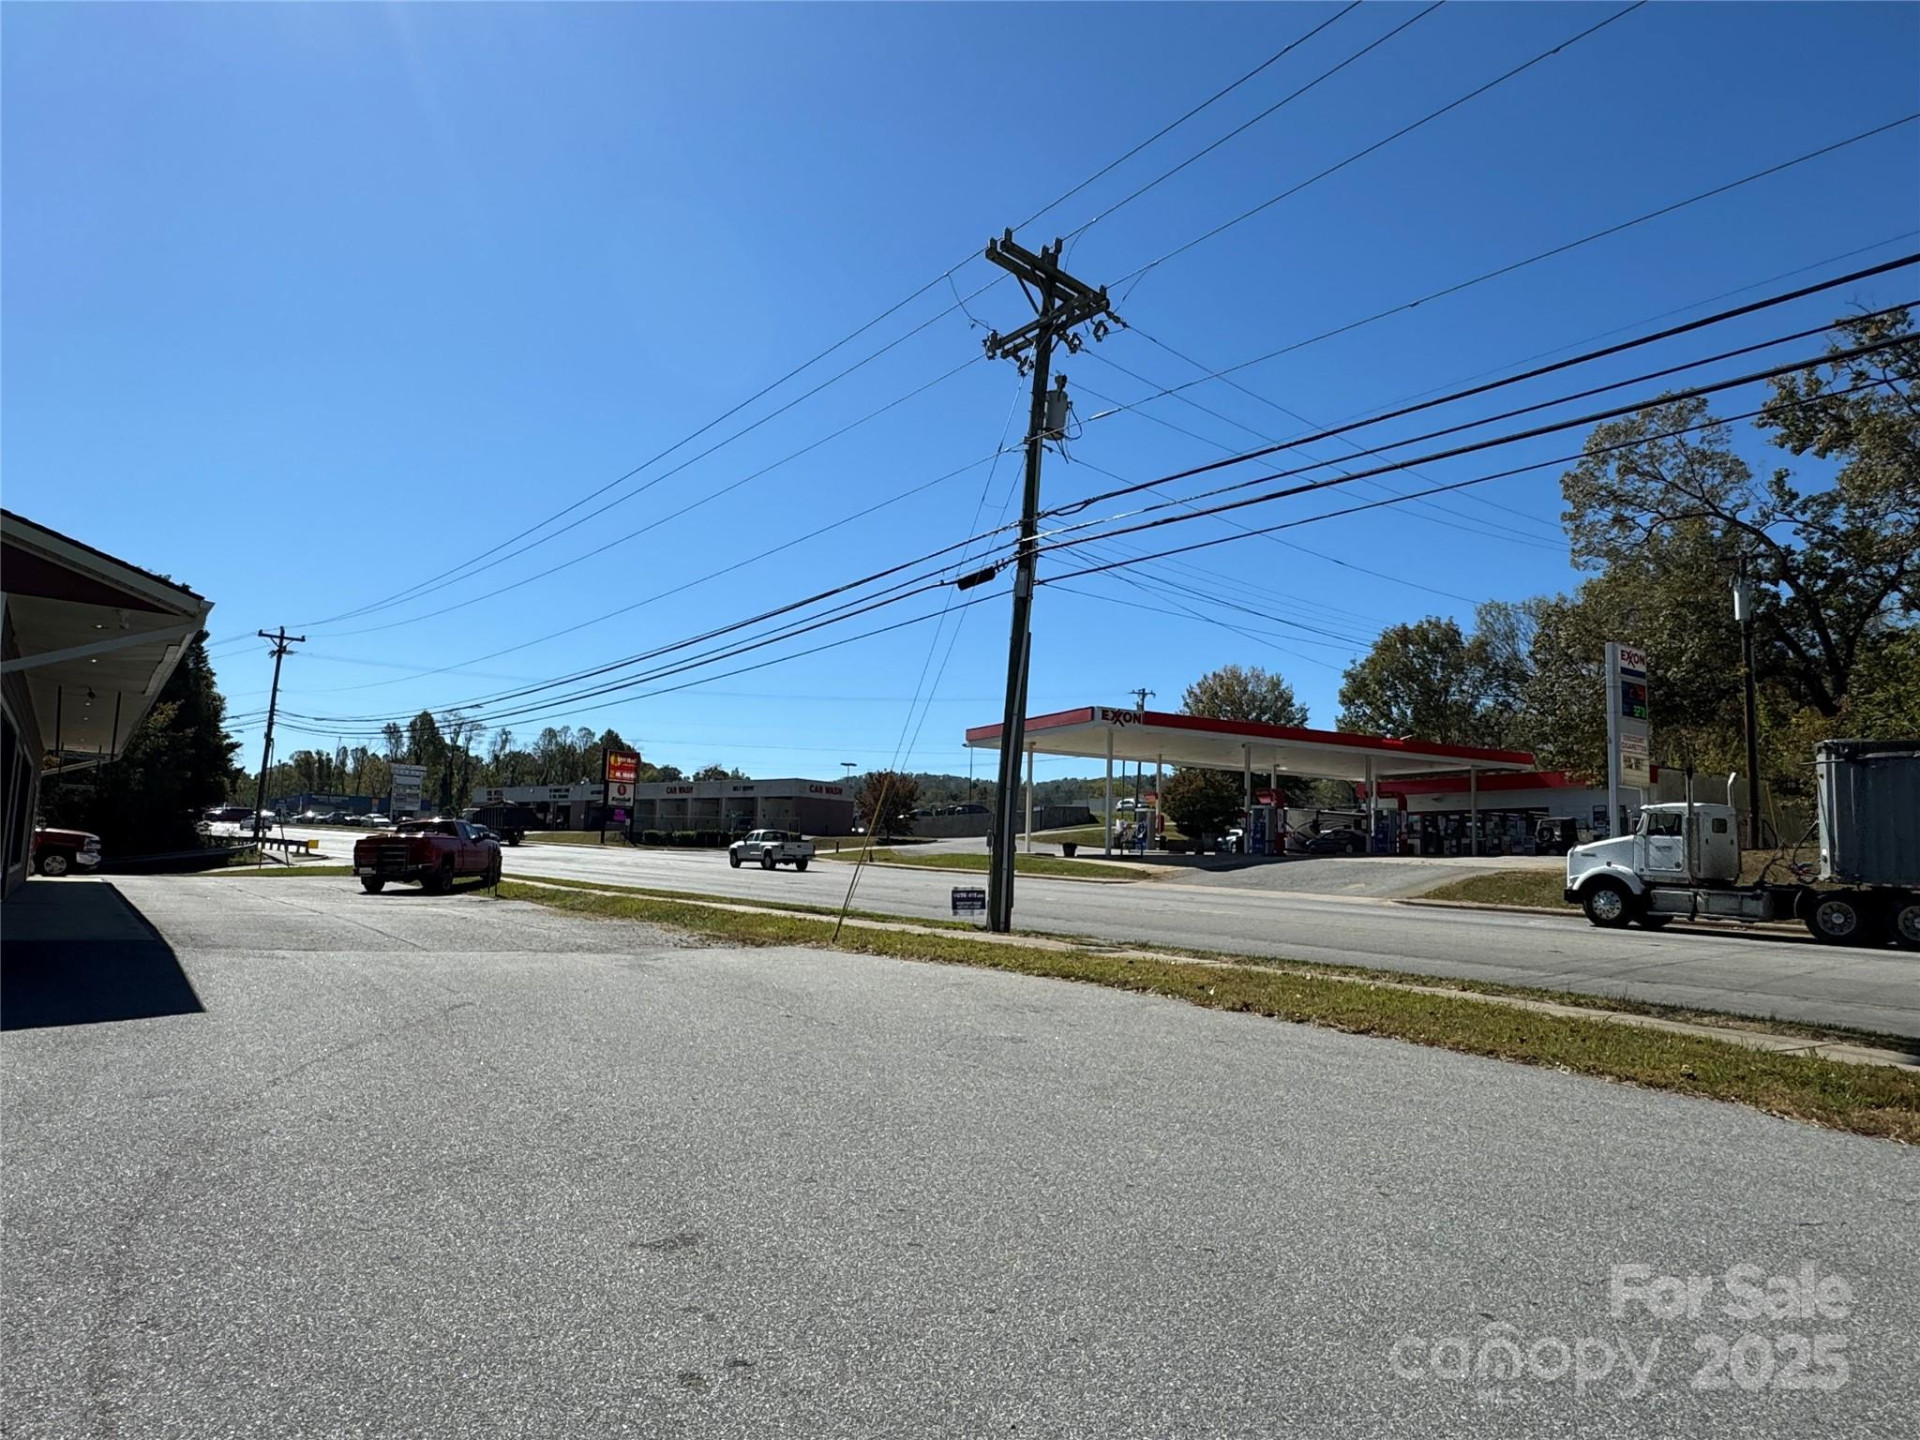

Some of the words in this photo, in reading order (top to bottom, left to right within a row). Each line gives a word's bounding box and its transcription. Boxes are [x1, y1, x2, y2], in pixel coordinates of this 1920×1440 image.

[1621, 649, 1646, 668] EXXON
[1101, 709, 1142, 727] EXXON
[666, 786, 677, 795] CAR
[678, 785, 694, 795] WASH
[809, 784, 823, 794] CAR
[825, 785, 843, 796] WASH
